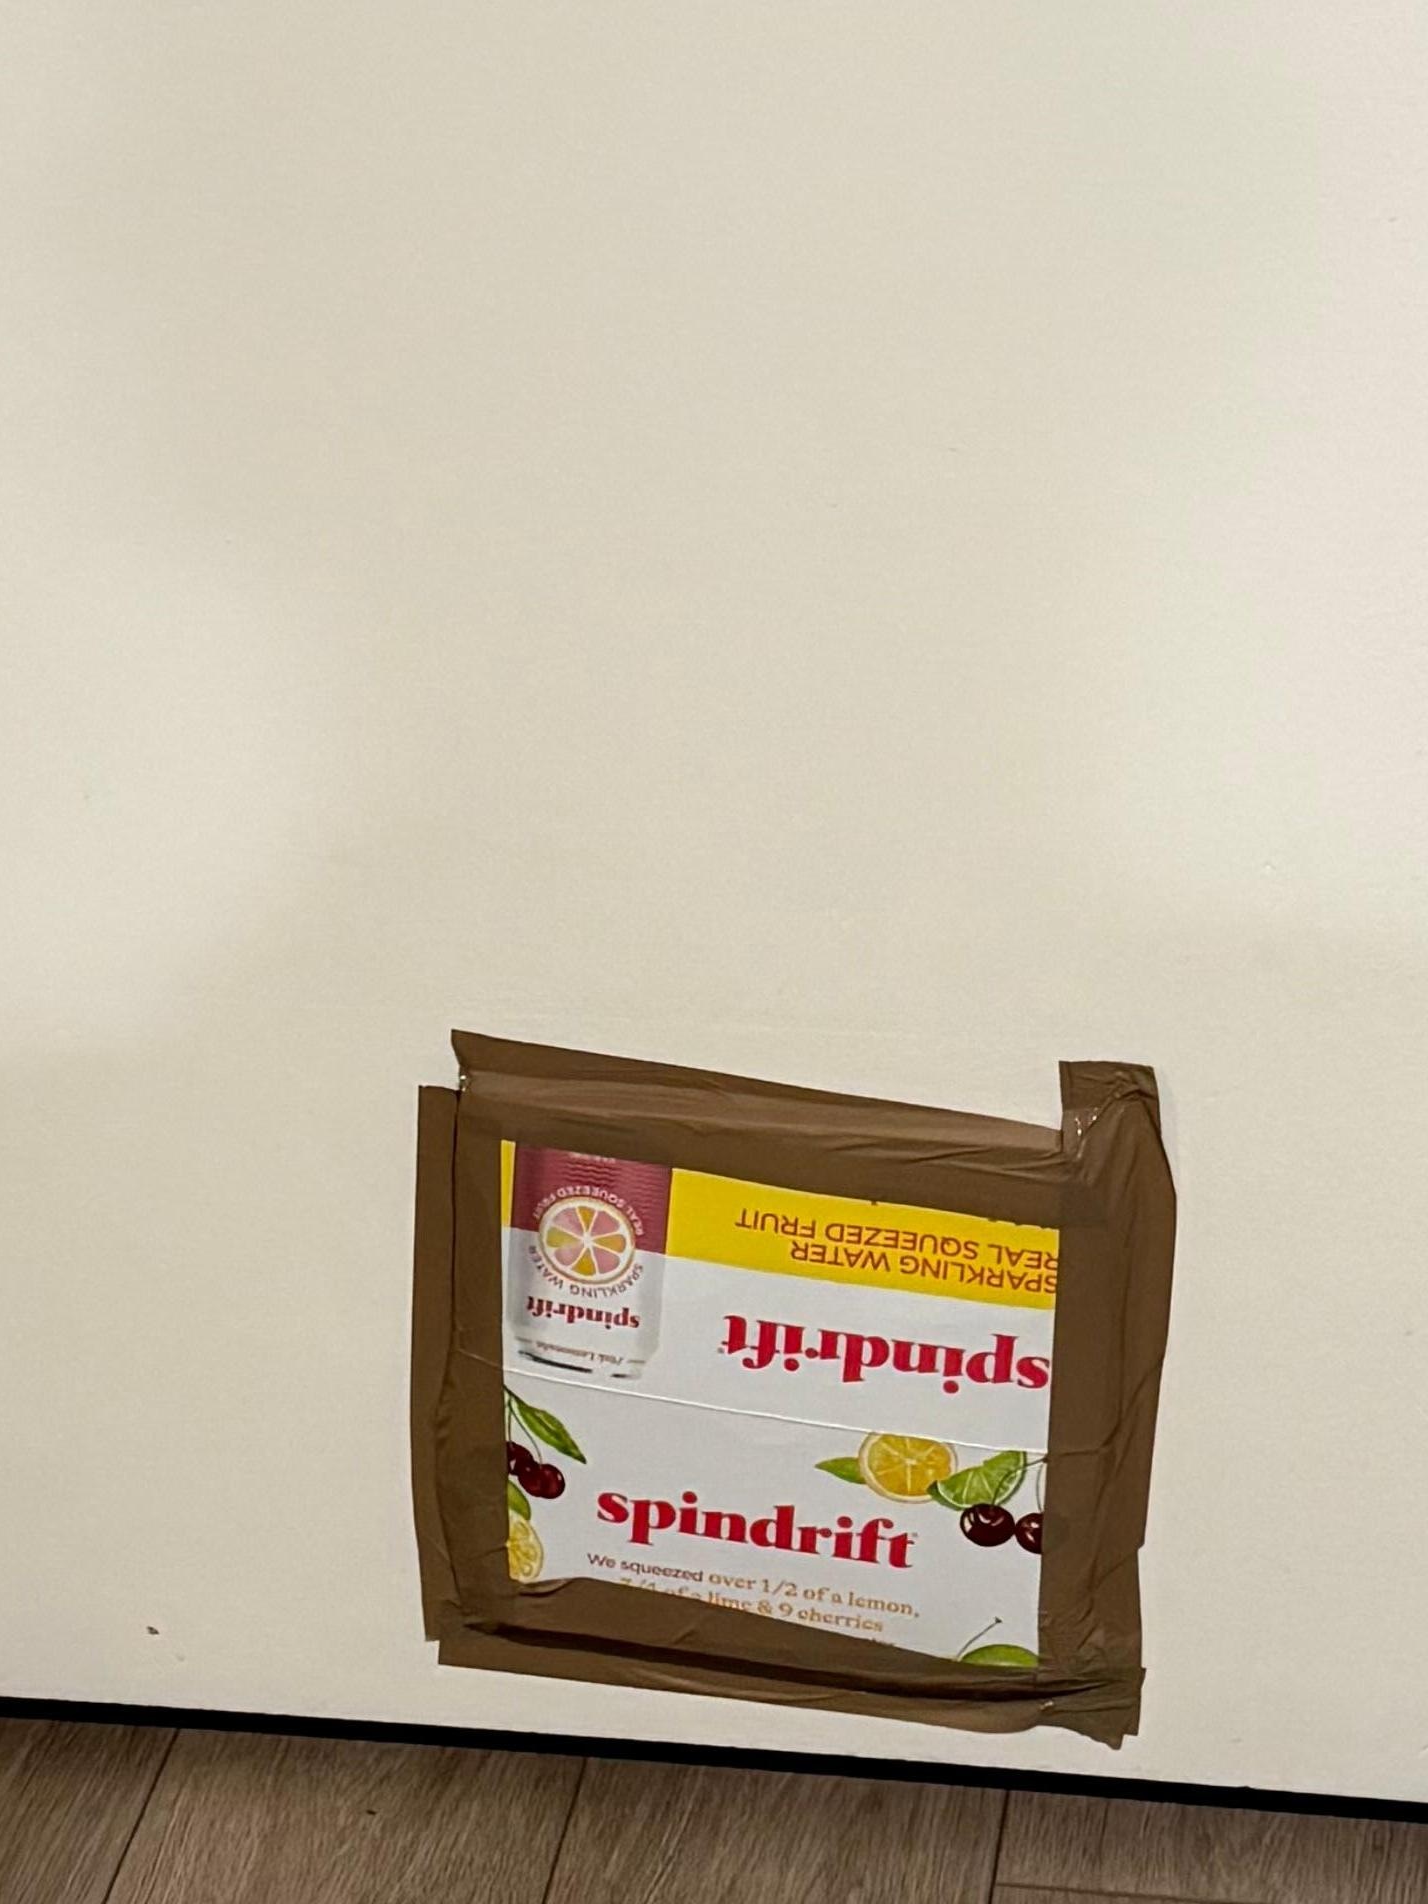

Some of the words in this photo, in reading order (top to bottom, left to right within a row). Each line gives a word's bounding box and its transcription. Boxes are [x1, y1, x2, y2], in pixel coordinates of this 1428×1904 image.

[734, 1208, 816, 1239] FRUIT
[824, 1222, 980, 1260] SQUEEZED
[790, 1241, 890, 1272] WATER
[899, 1254, 1057, 1294] SPARKLING
[987, 1243, 1058, 1271] REAL
[570, 1263, 643, 1298] SPARKLING
[527, 1295, 641, 1330] spindrift
[721, 1314, 1051, 1394] spindrift
[596, 1491, 915, 1569] spindrift
[587, 1553, 616, 1569] We
[620, 1560, 704, 1583] squeezed
[708, 1573, 757, 1590] over
[762, 1578, 798, 1597] 1/2
[803, 1586, 830, 1601] of
[831, 1592, 843, 1605] a
[779, 1602, 793, 1617] 9
[798, 1607, 884, 1633] cherries
